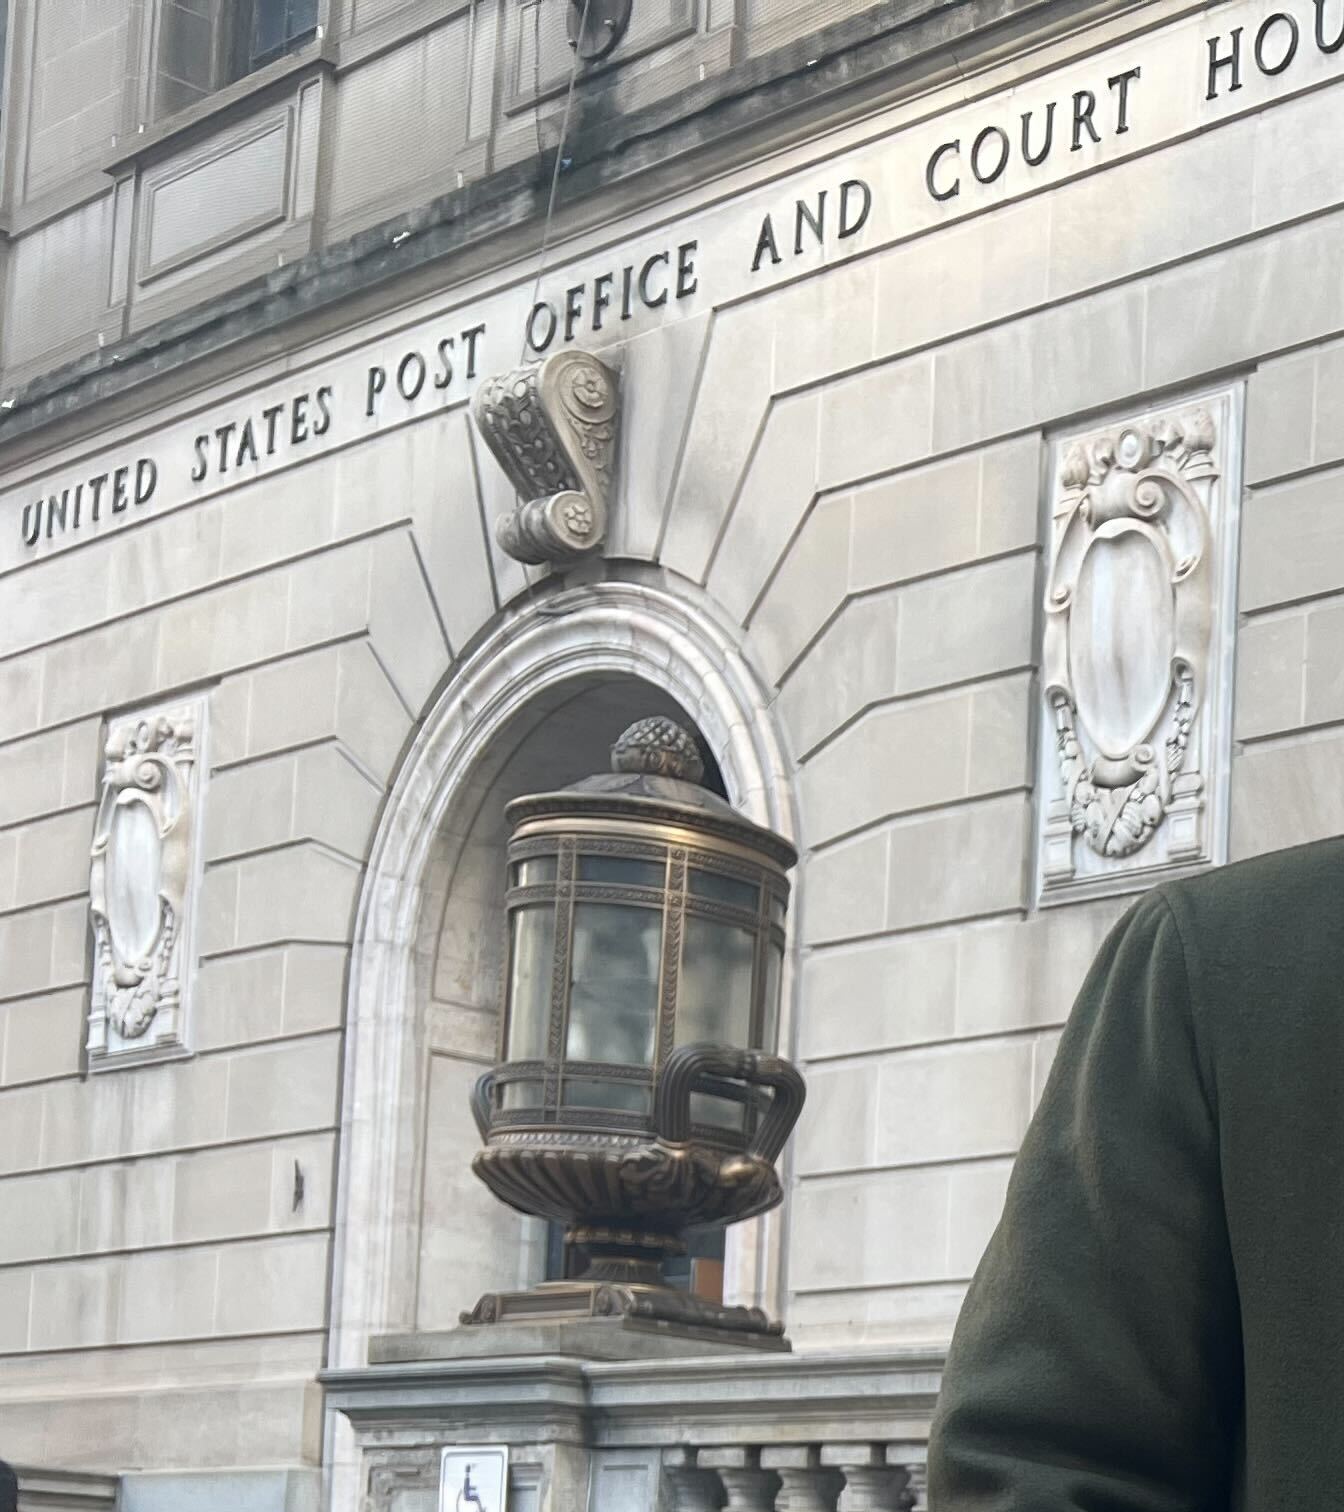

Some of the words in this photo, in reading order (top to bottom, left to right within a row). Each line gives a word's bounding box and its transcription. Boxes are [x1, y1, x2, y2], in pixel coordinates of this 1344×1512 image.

[21, 457, 158, 546] UNITED
[191, 385, 333, 482] STATES
[365, 323, 486, 417] POST
[526, 239, 698, 353] OFFICE
[750, 179, 872, 272] AND
[925, 66, 1141, 201] COURT
